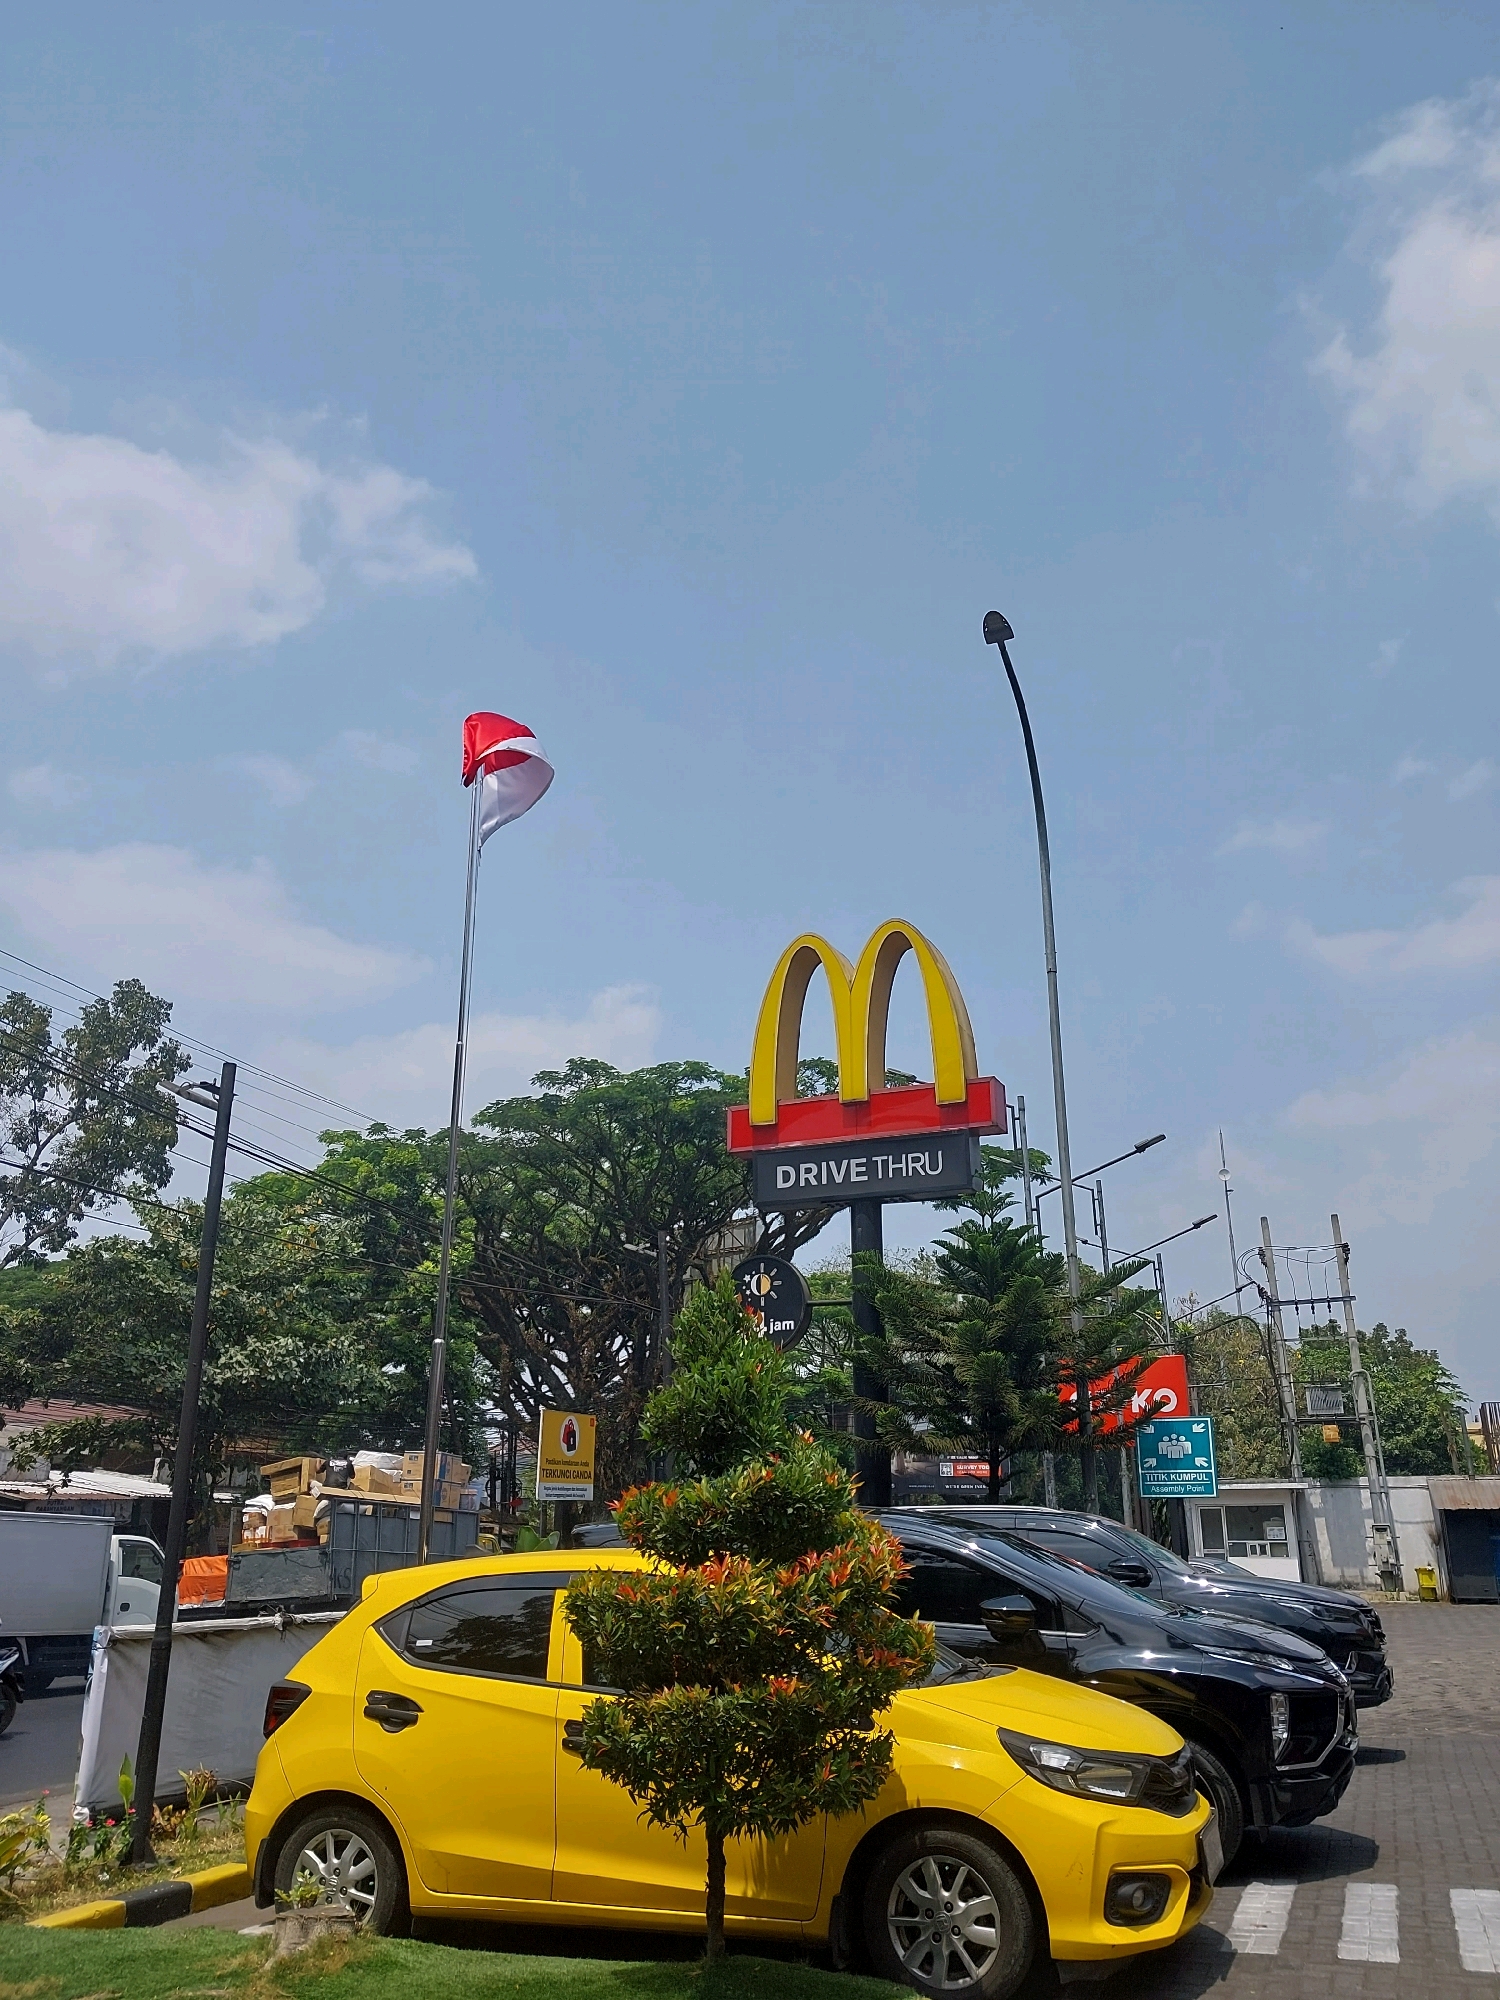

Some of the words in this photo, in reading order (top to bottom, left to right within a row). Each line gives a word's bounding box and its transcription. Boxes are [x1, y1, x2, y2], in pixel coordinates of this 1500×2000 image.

[776, 1157, 868, 1189] DRIVE
[872, 1150, 944, 1179] THRU
[769, 1318, 795, 1335] jam
[542, 1468, 572, 1478] TERKUNCI
[572, 1470, 592, 1480] GANDA
[1145, 1473, 1168, 1481] TITIK
[1170, 1472, 1210, 1481] KUMPUL
[1151, 1485, 1185, 1493] Assembly
[1186, 1484, 1205, 1492] Point
